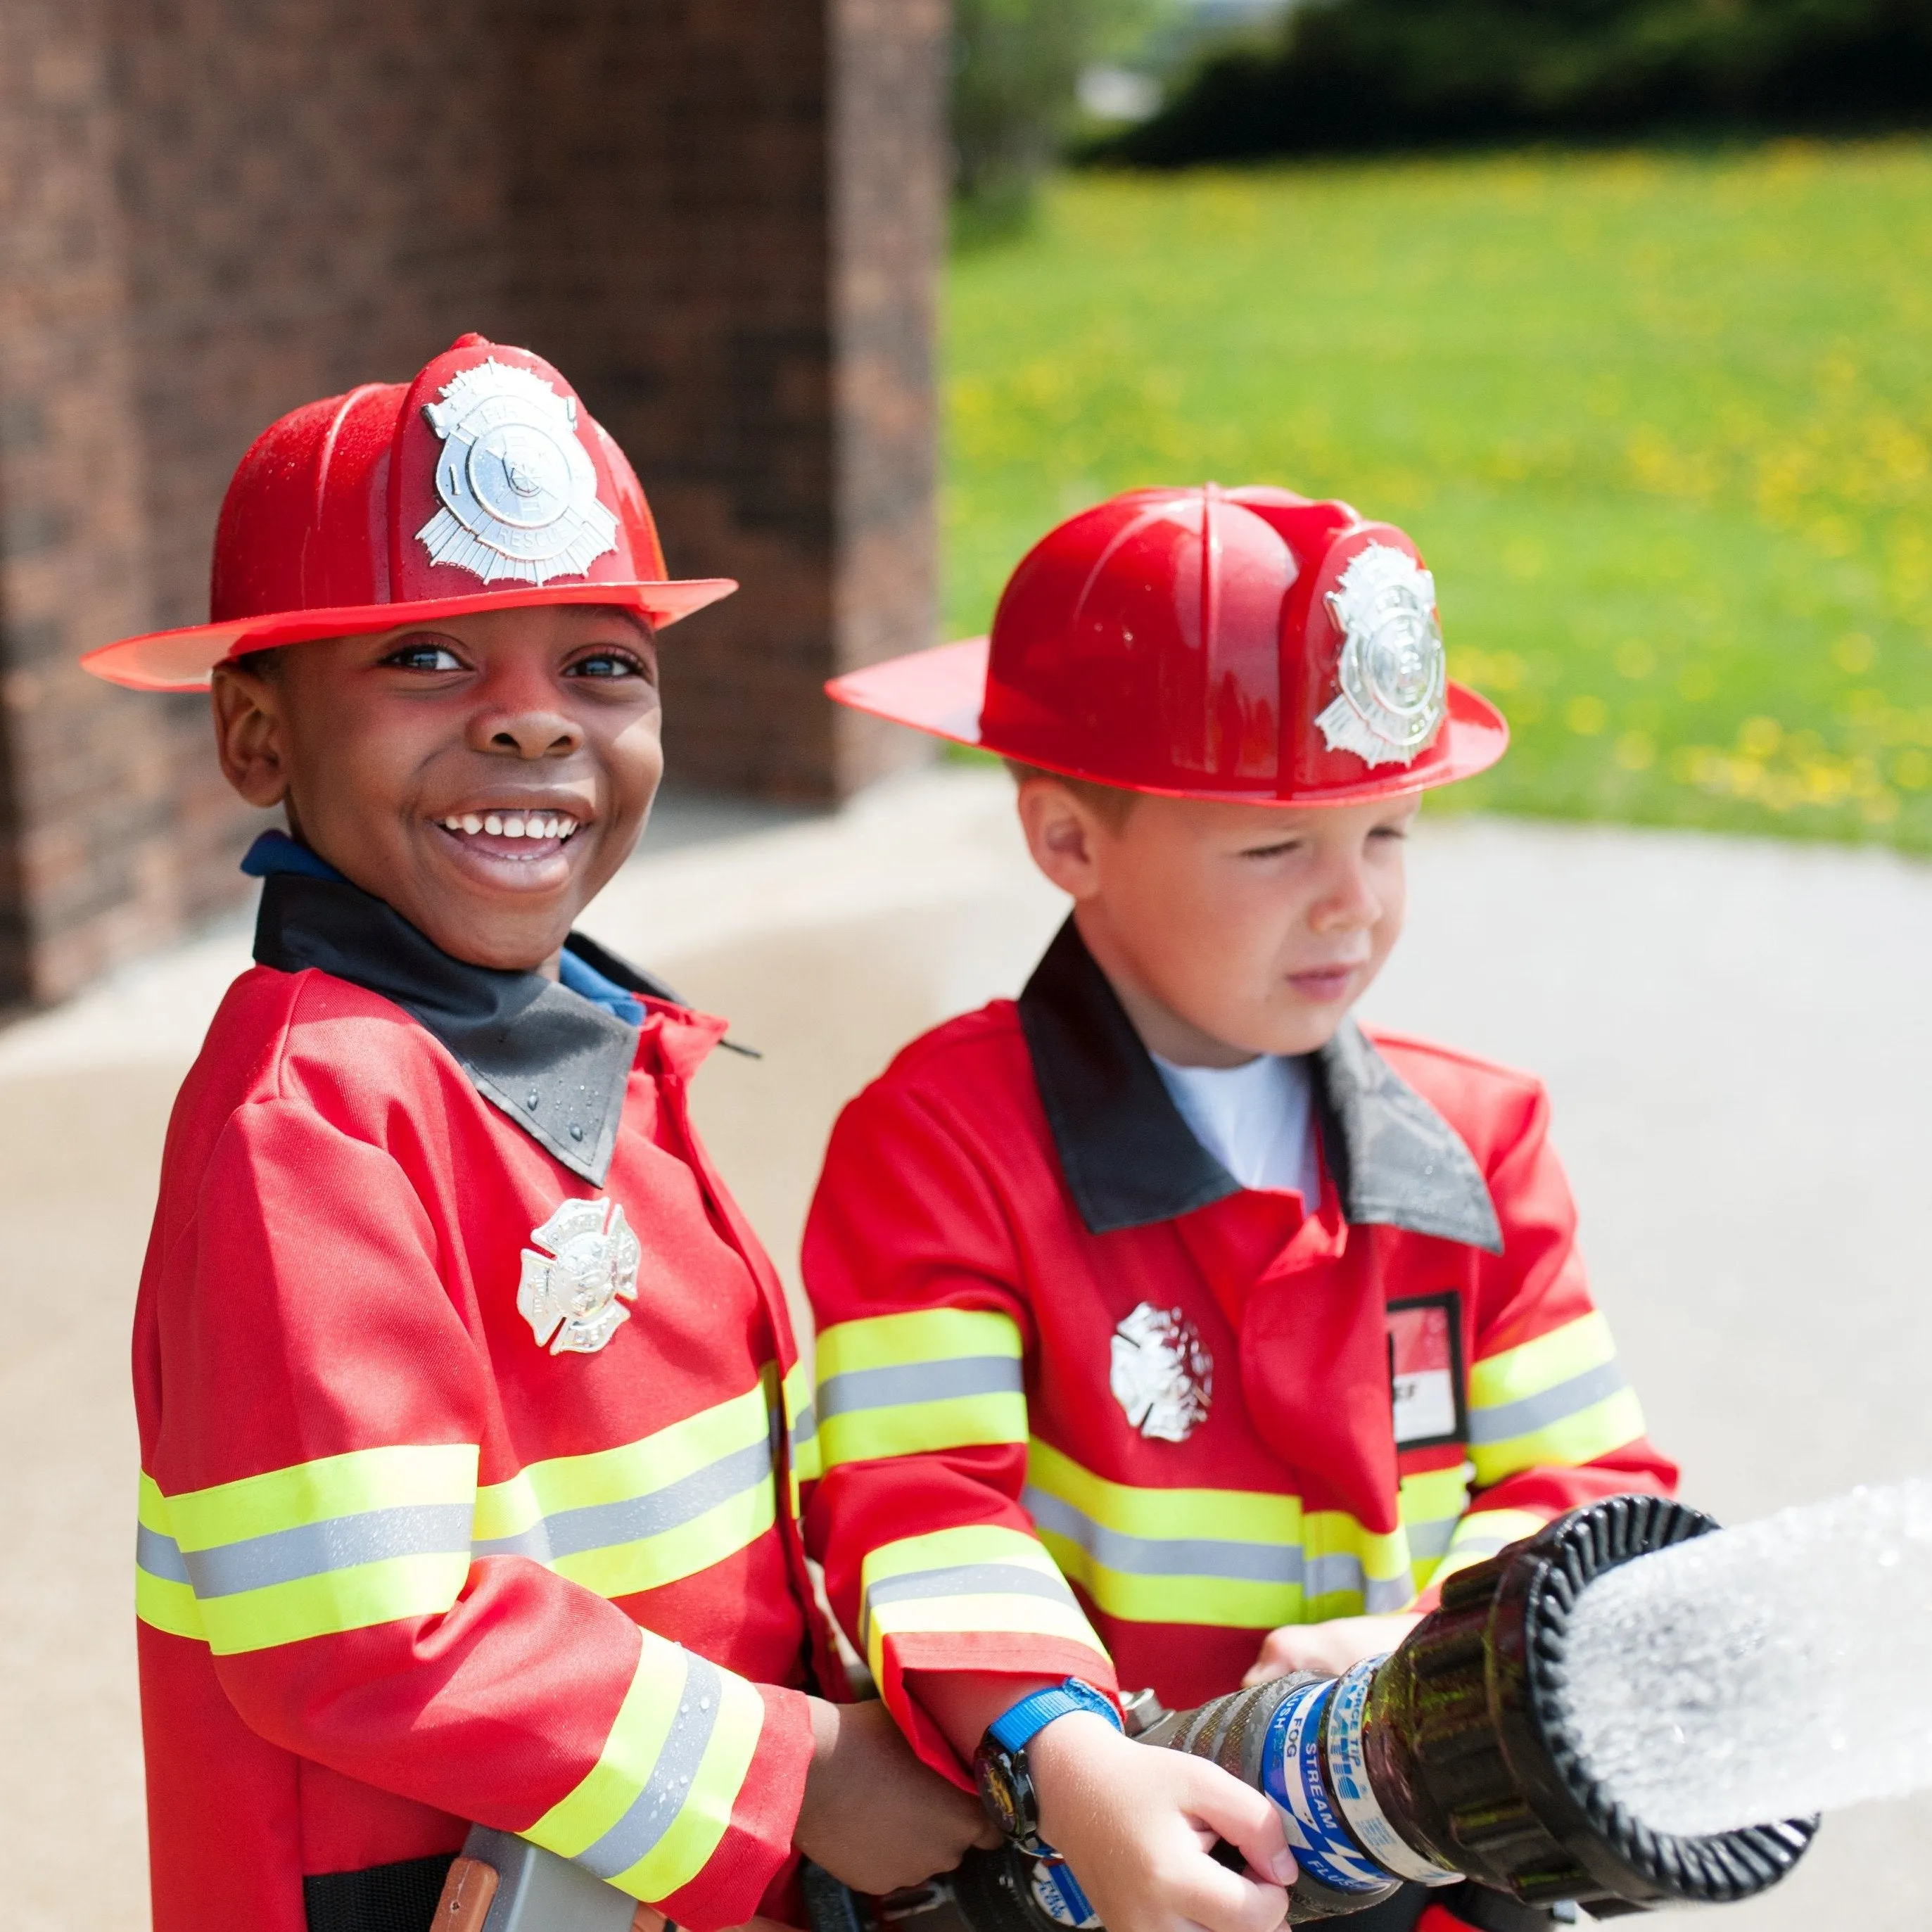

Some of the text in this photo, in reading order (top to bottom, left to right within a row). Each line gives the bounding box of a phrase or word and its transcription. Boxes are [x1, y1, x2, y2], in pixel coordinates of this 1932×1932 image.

[497, 527, 567, 548] RESCUE
[1287, 1718, 1302, 1757] FOG
[1305, 1743, 1337, 1829] STREAM
